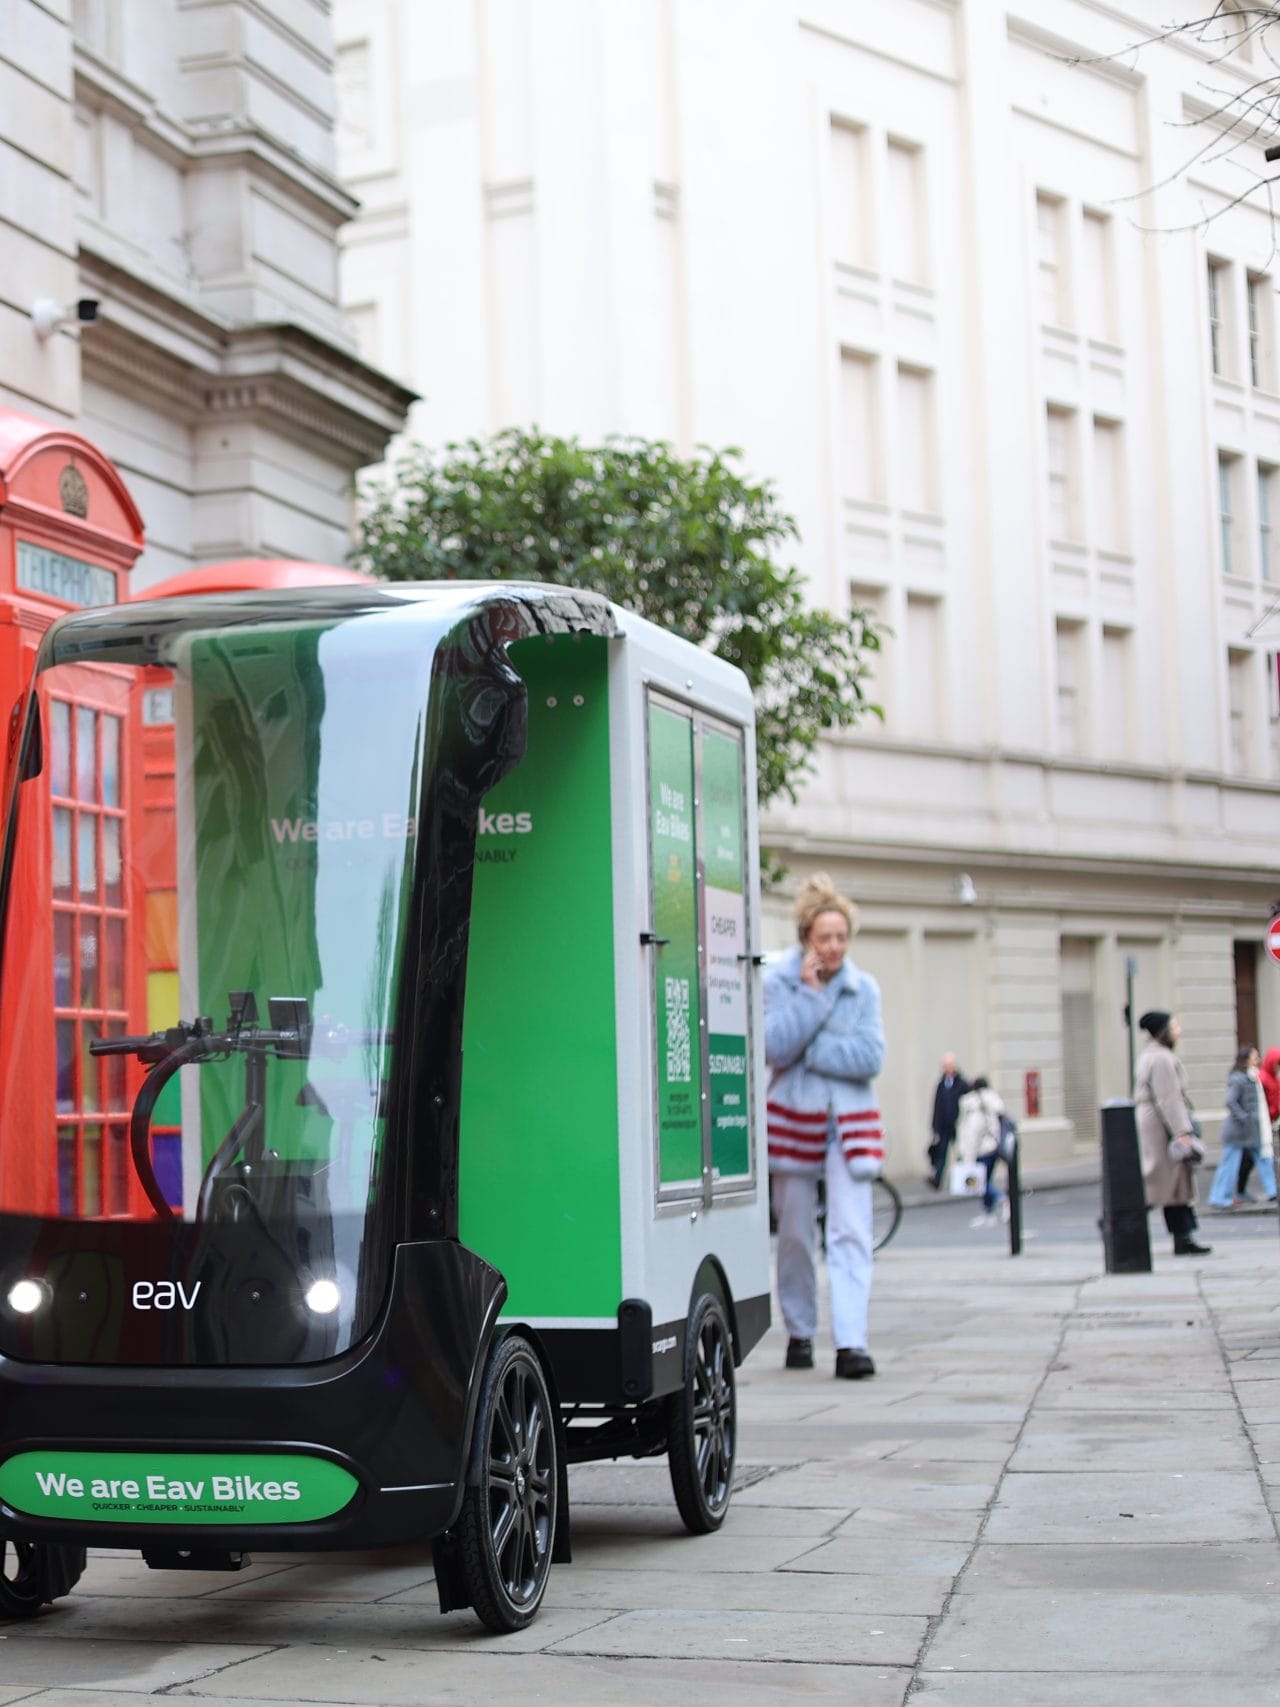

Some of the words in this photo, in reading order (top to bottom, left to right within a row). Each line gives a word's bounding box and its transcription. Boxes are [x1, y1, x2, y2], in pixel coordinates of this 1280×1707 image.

[271, 816, 318, 844] We
[325, 818, 375, 843] are
[382, 814, 418, 840] Ea
[477, 807, 533, 835] kes
[132, 1280, 202, 1311] eav
[35, 1471, 85, 1498] We
[91, 1477, 140, 1500] are
[146, 1475, 205, 1501] Eav
[212, 1475, 302, 1501] Bikes
[91, 1502, 131, 1512] QUICKER
[136, 1504, 178, 1513] CHEAPER
[184, 1504, 246, 1513] SUSTAINABLY
